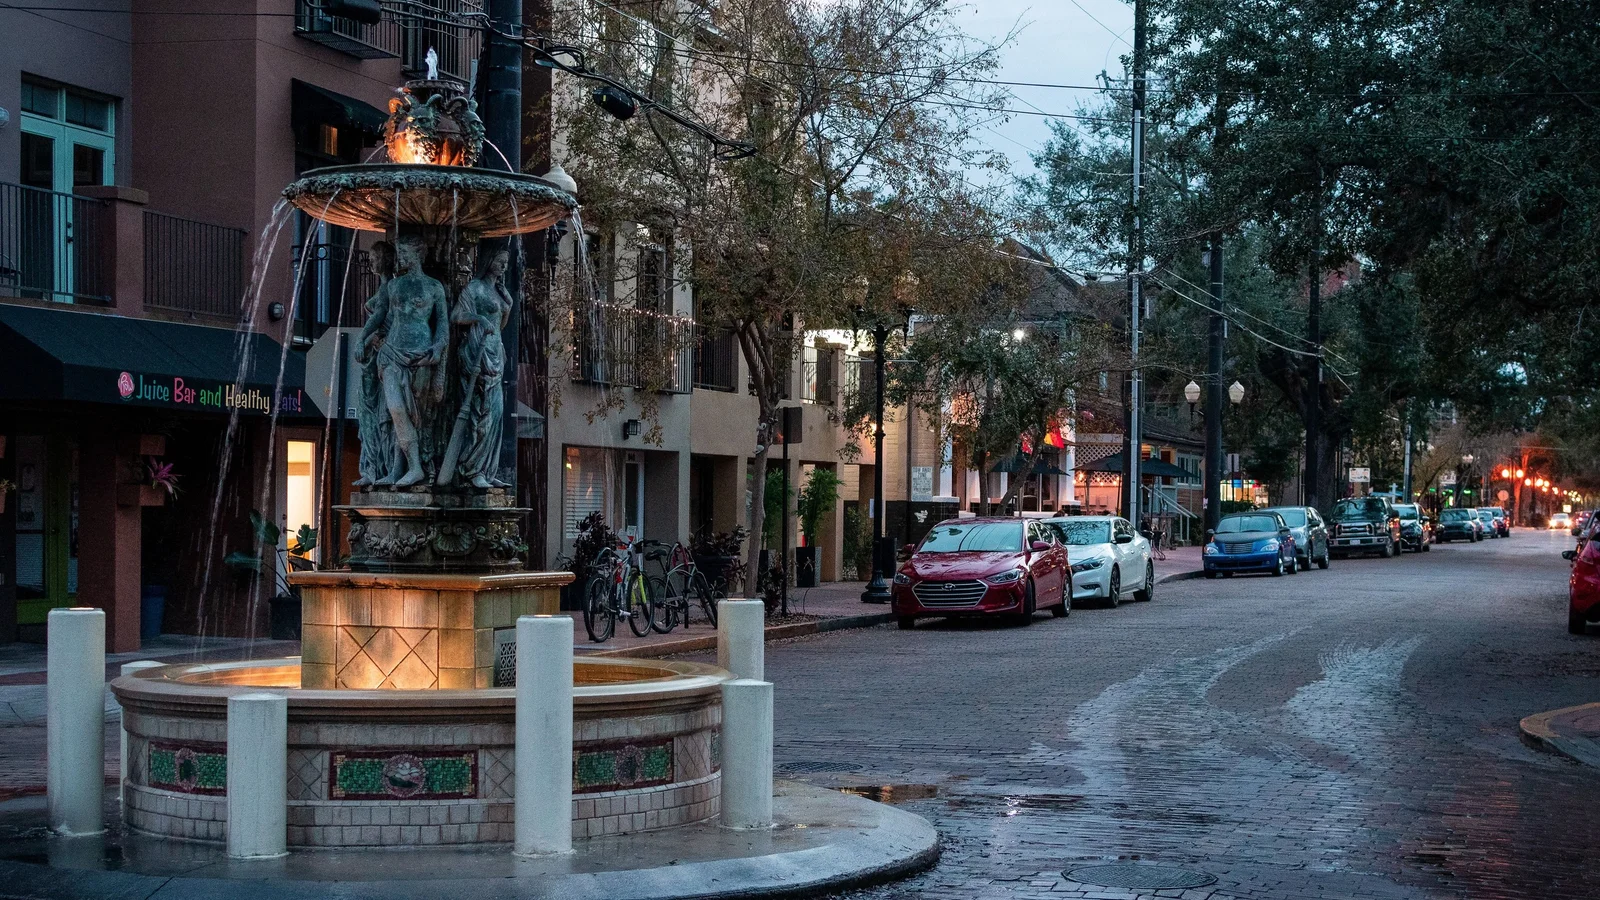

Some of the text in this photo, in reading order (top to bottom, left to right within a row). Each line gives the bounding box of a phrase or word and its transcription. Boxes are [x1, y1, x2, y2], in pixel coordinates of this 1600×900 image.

[135, 374, 169, 402] Juice
[173, 377, 197, 404] Bar
[199, 385, 222, 407] and
[225, 384, 270, 415] Healthy
